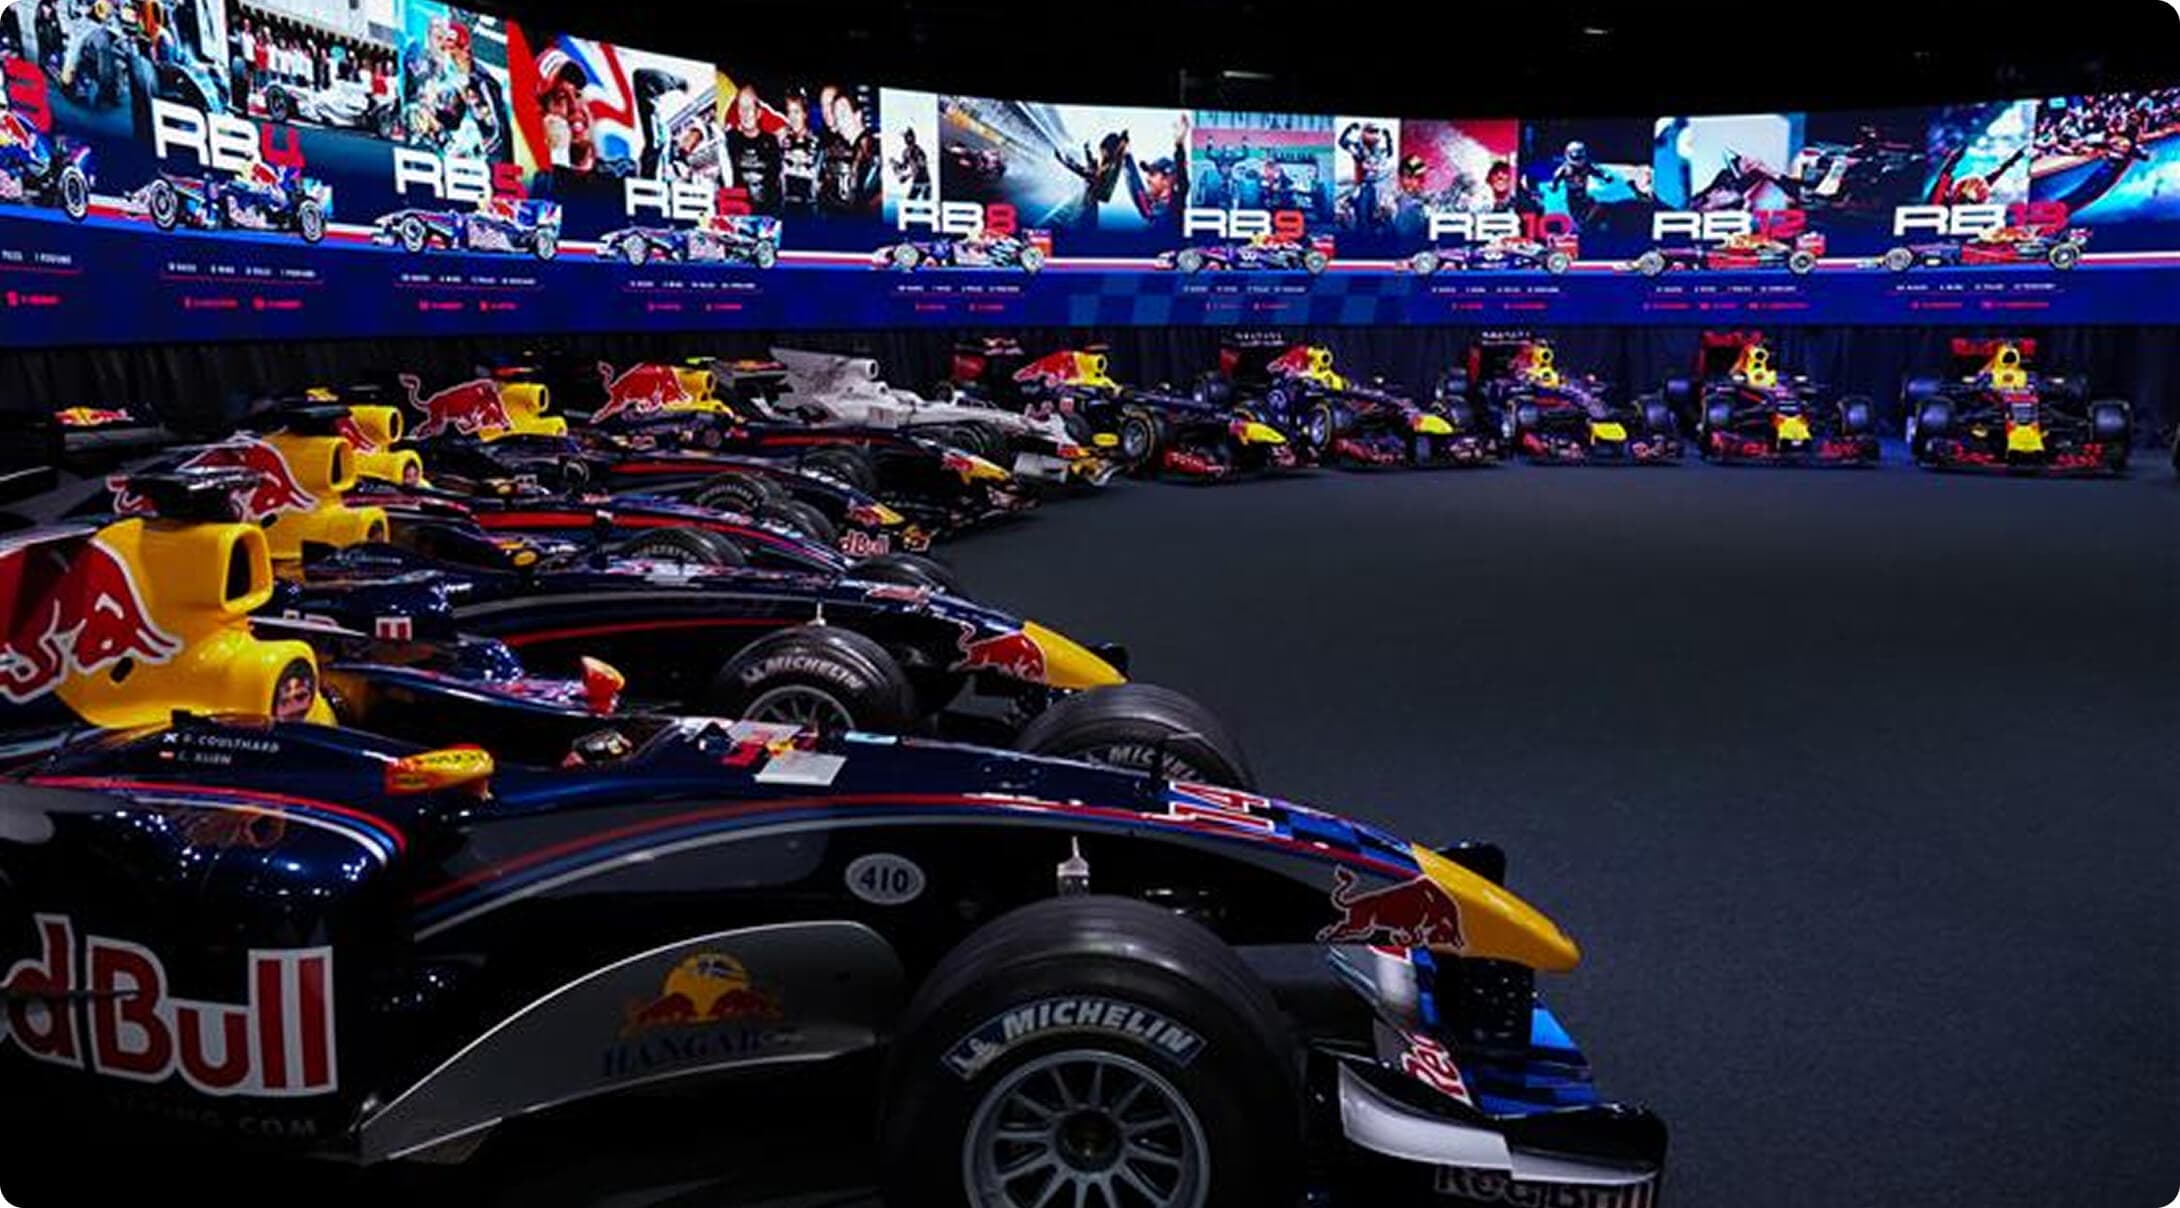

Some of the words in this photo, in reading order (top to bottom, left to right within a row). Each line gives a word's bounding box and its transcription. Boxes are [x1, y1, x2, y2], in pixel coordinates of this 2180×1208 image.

[151, 97, 306, 172] RB4
[393, 146, 528, 203] RB5
[898, 200, 1018, 235] RB8
[1184, 208, 1304, 240] RB9
[1430, 212, 1573, 241] RB10
[1652, 210, 1806, 241] RB12
[1893, 201, 2068, 237] RB13
[861, 866, 908, 893] 410
[1000, 1000, 1196, 1054] MICHELIN
